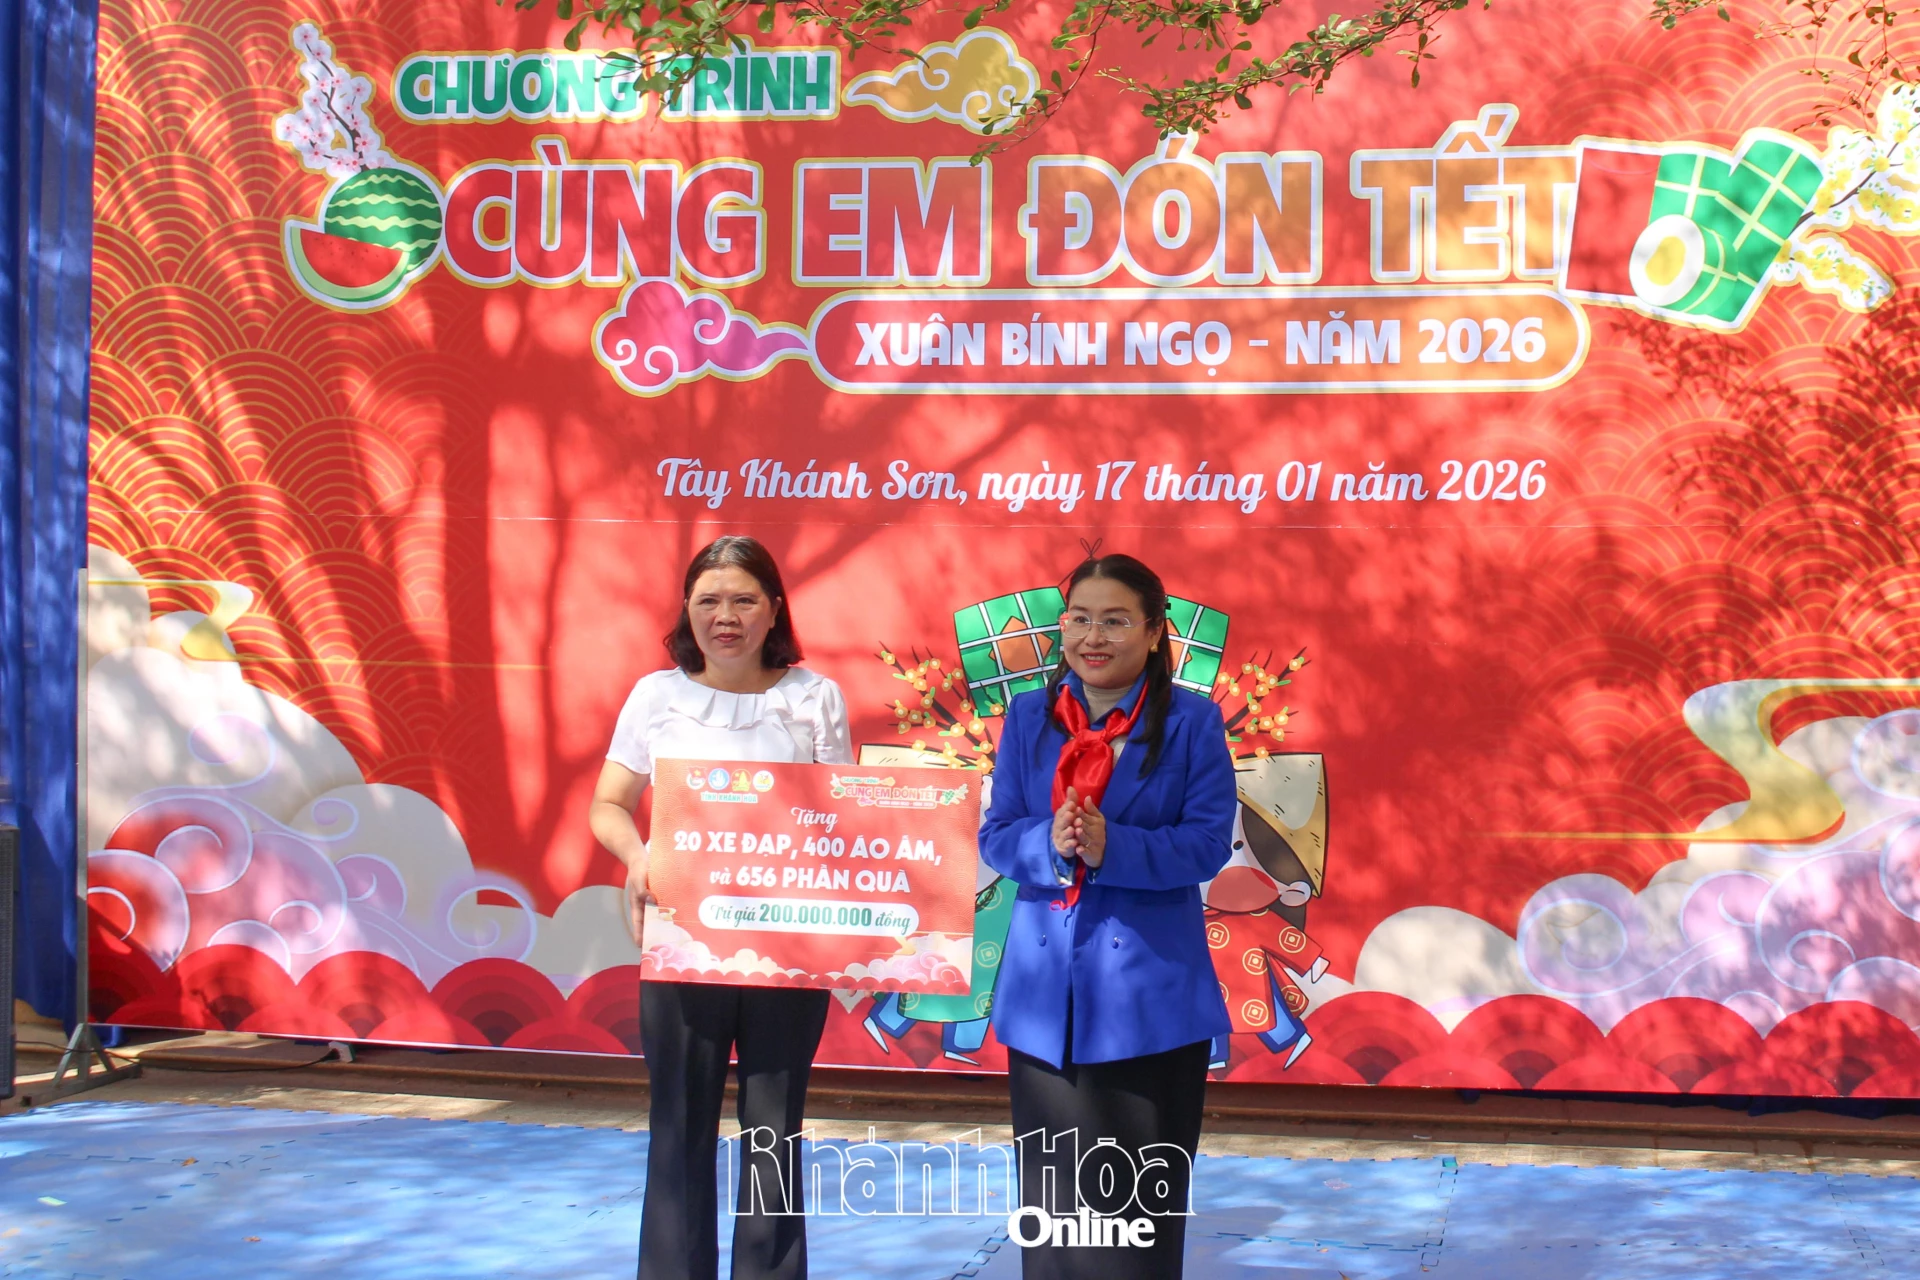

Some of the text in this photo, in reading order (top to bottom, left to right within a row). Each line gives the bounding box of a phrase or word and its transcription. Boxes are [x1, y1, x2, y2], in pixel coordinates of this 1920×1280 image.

[398, 42, 831, 116] CHƯƠNG TRÌNH
[443, 108, 1578, 283] CÙNG EM ĐÓN TẾT
[854, 310, 1547, 377] XUÂN BÍNH NGỌ - NĂM 2026
[656, 457, 1547, 514] Tây Khánh Sơn, ngày 17 tháng 01 năm 2026
[875, 787, 890, 798] EM
[790, 806, 838, 834] Tặng
[674, 830, 702, 852] 20
[706, 831, 738, 853] XE
[741, 832, 798, 860] ĐẠP,
[802, 836, 846, 858] 400
[849, 834, 891, 860] ÁO
[709, 863, 911, 893] và 656 PHẦN QUÀ
[734, 907, 757, 928] giá
[758, 902, 873, 928] 200.000.000
[874, 910, 911, 936] đồng
